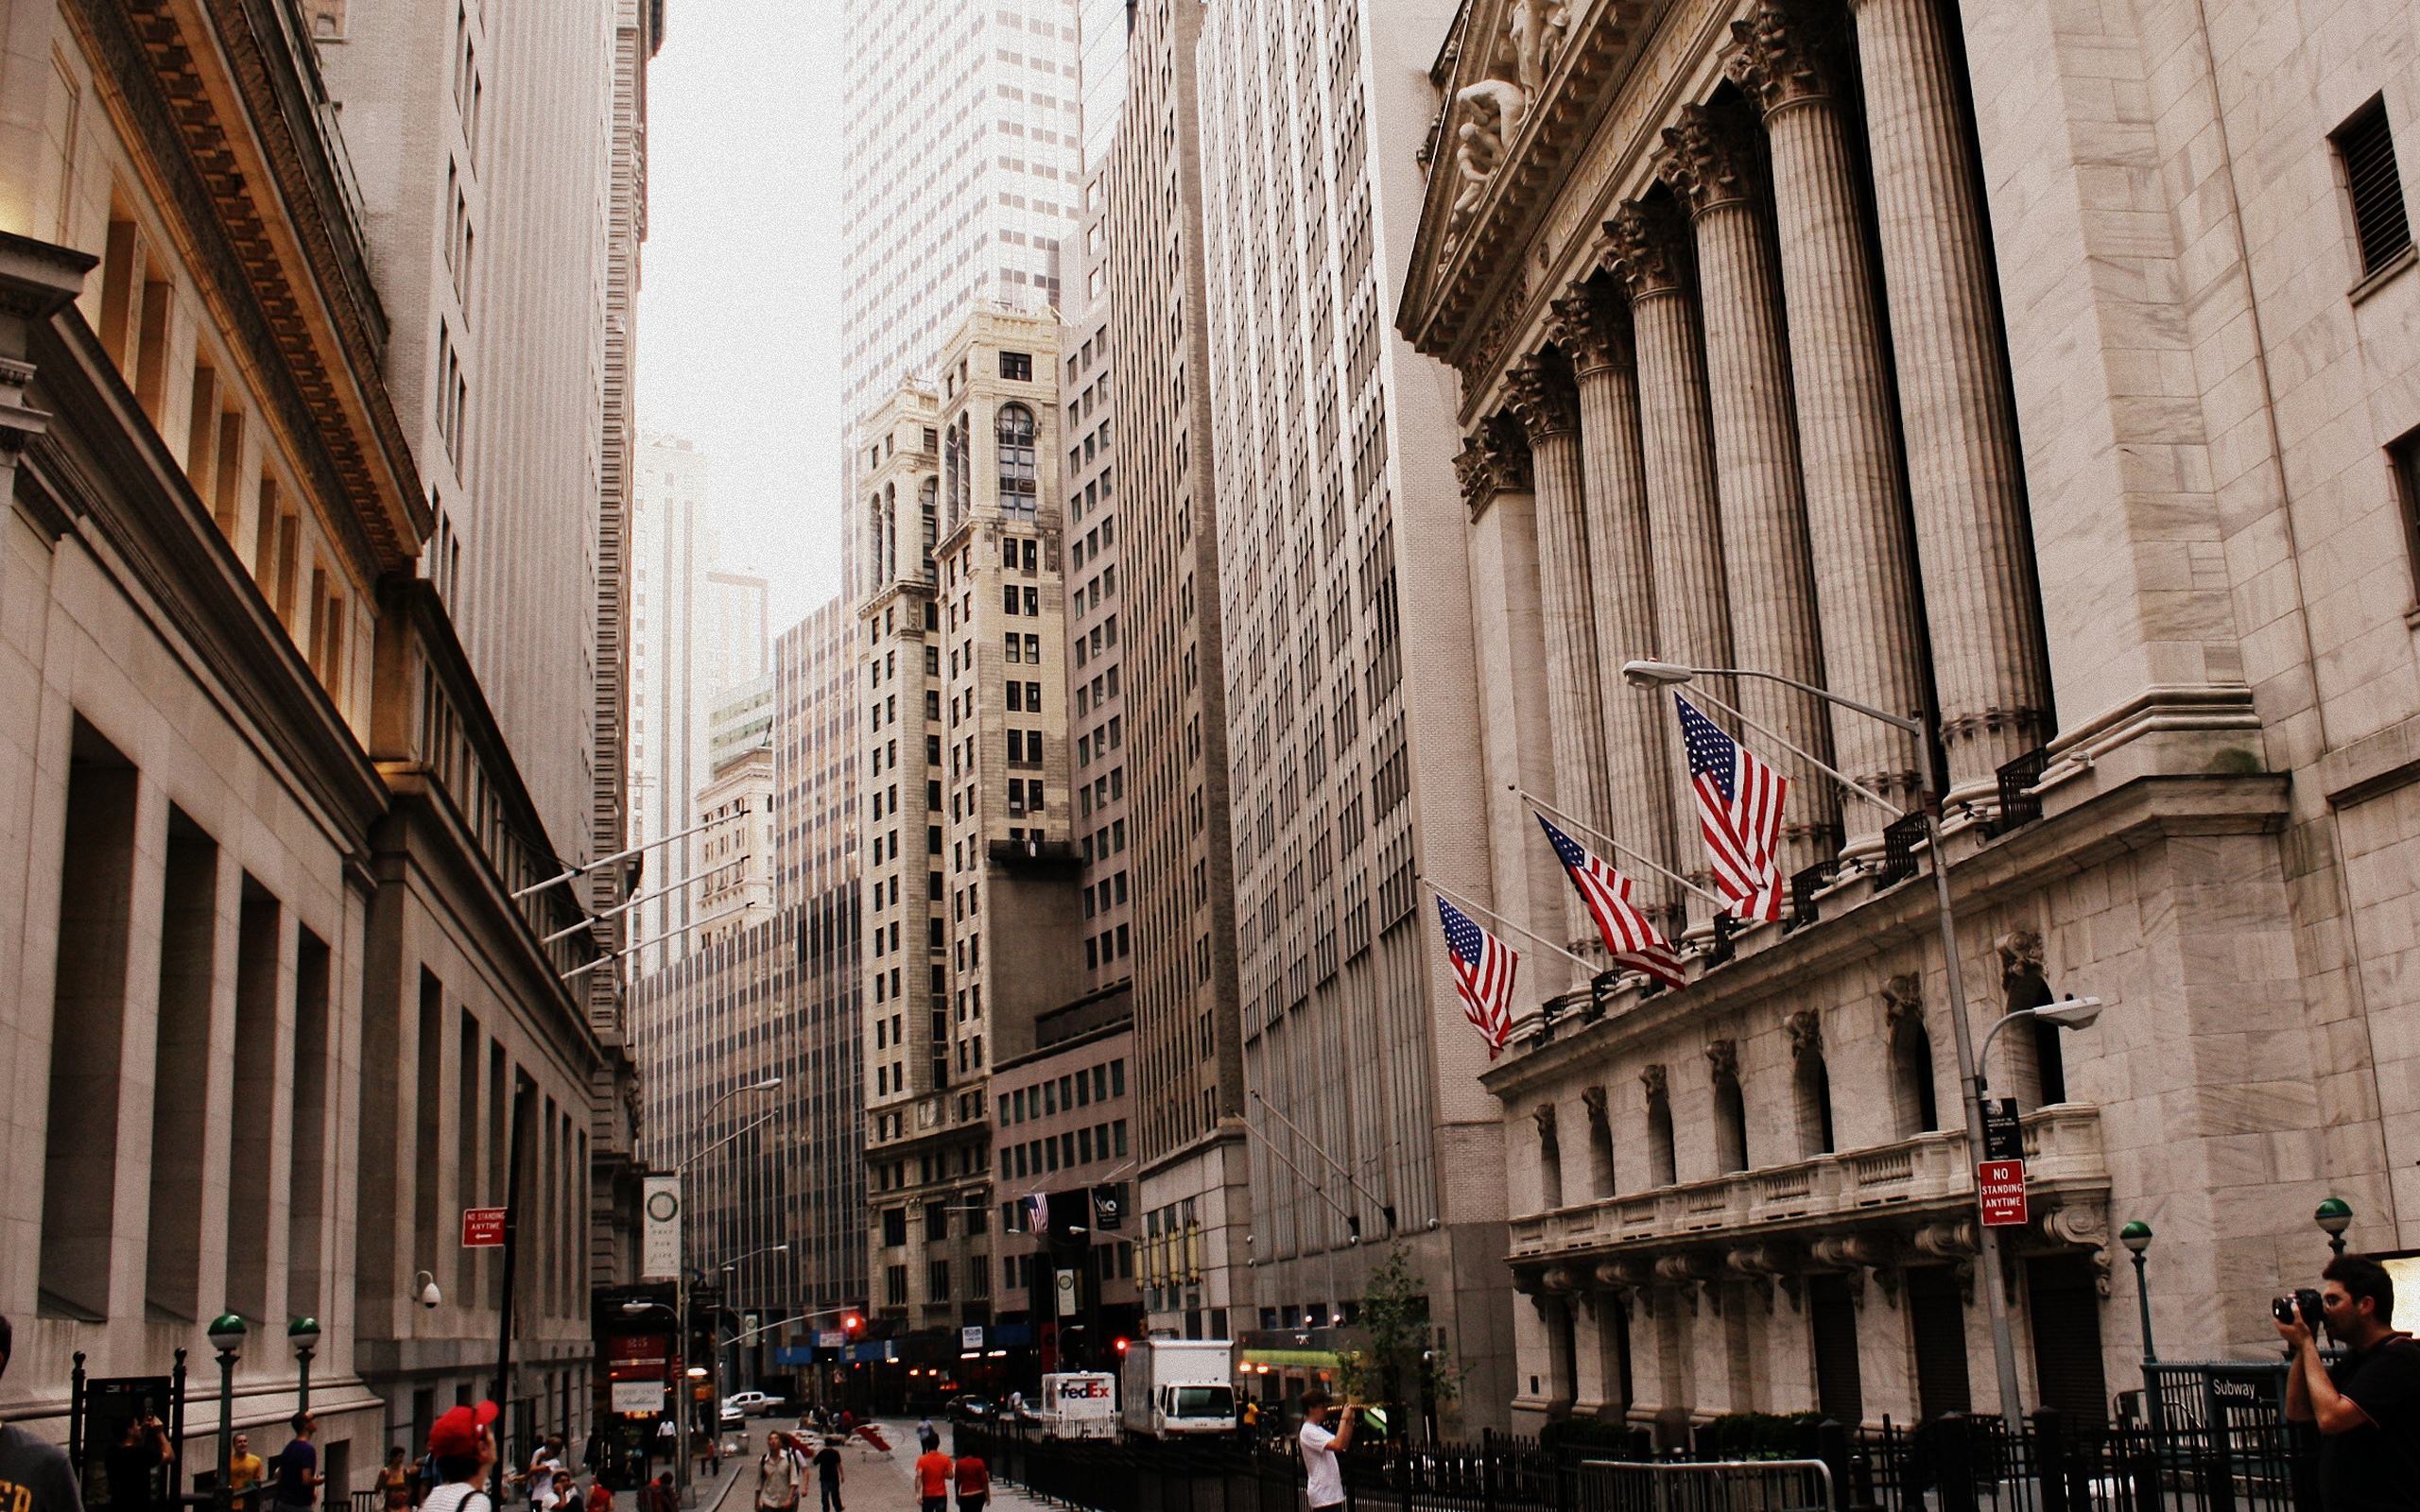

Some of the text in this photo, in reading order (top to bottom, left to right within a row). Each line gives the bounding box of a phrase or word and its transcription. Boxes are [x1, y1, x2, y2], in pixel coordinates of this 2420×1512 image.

[1993, 1168, 2009, 1181] NO
[1981, 1183, 2023, 1195] STANDING
[1985, 1196, 2021, 1209] ANYTIME
[471, 1222, 500, 1230] ANYTIME
[1060, 1381, 1110, 1400] FedEx
[2213, 1379, 2256, 1400] Subway
